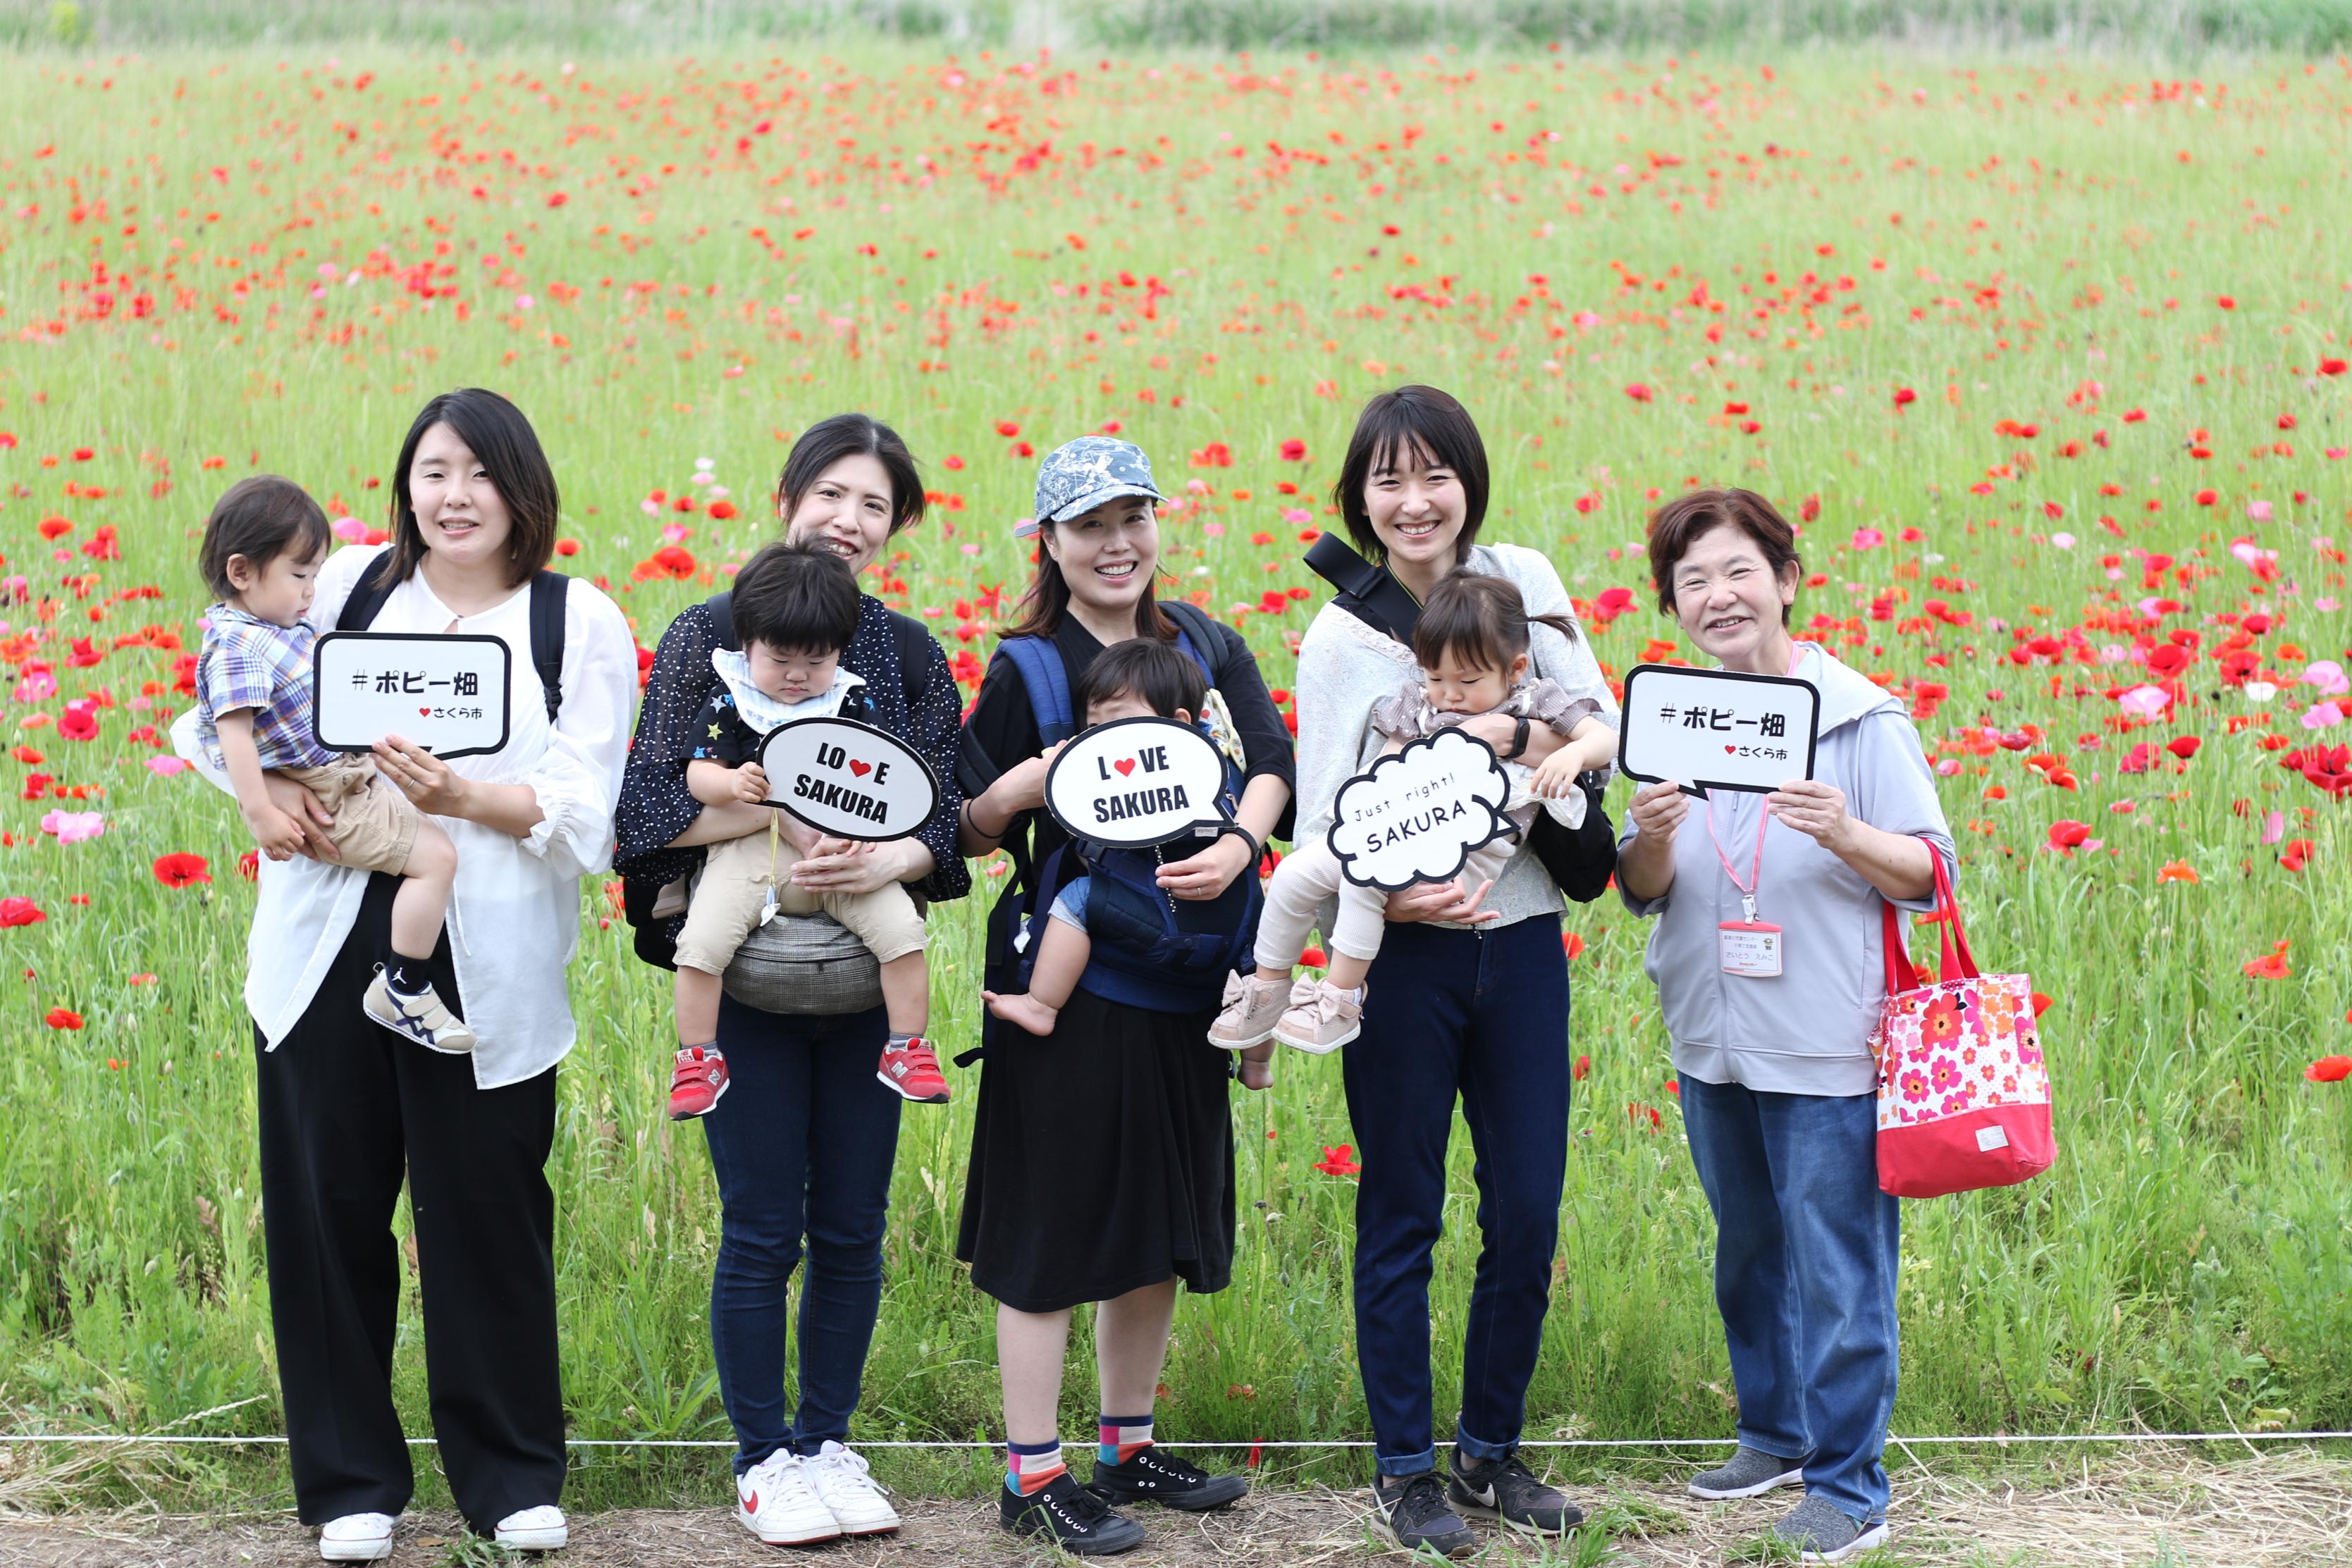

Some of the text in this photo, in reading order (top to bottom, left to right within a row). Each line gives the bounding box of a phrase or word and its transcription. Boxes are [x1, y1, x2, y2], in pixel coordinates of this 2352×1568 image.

[433, 707, 483, 720] さくら市
[816, 742, 890, 785] LOE
[1097, 746, 1169, 780] LVE
[1739, 745, 1788, 761] さくら市
[794, 774, 888, 824] SAKURA
[1093, 784, 1190, 823] SAKURA
[1354, 772, 1455, 822] Just right!
[1367, 799, 1467, 853] SAKURA
